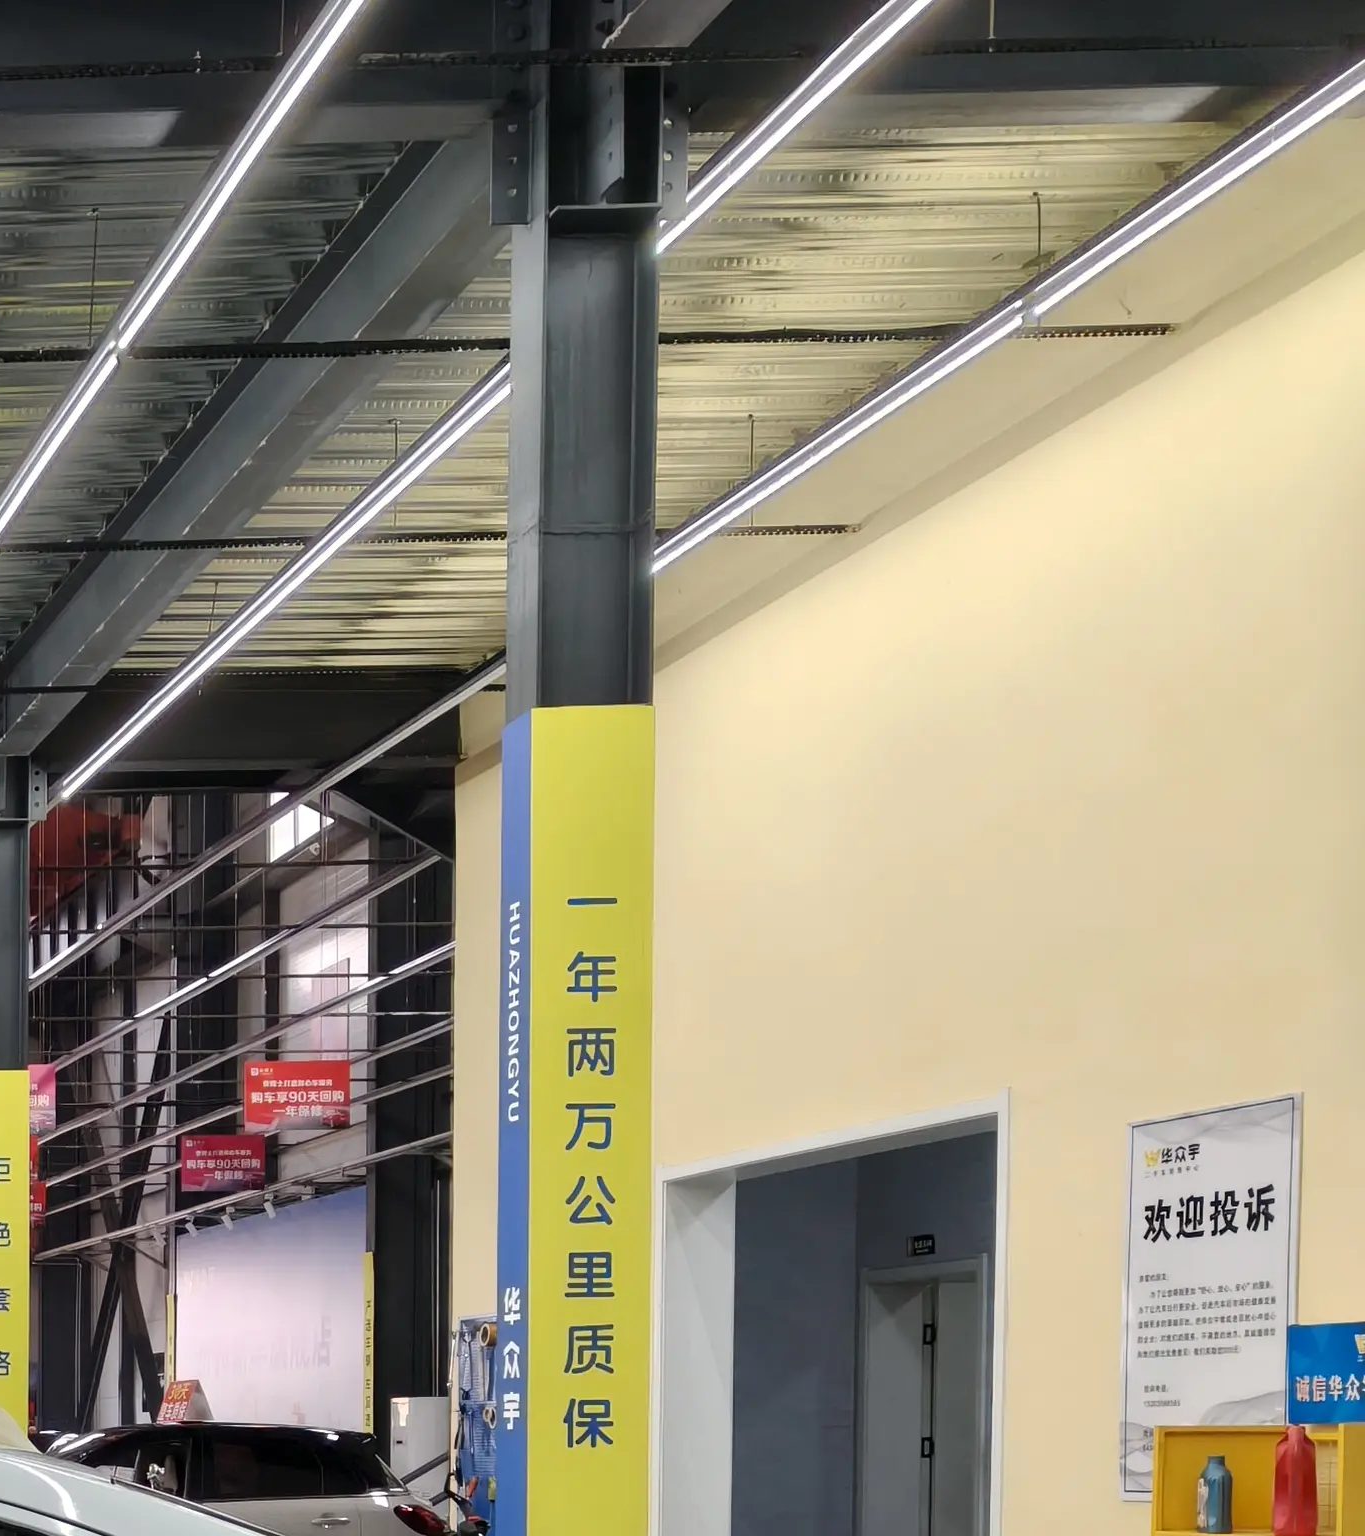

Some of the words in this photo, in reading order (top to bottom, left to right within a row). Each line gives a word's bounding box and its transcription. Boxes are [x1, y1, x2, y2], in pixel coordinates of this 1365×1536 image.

[508, 901, 521, 1122] HUAZHONGYU
[251, 1090, 344, 1104] 购车享90天回购
[273, 1105, 322, 1117] 一年保修
[186, 1159, 260, 1169] 购车享90天回购
[1161, 1143, 1201, 1164] 华众宇
[563, 897, 618, 1448] 一年两万公里质保
[1143, 1184, 1276, 1243] 欢迎投诉
[503, 1287, 521, 1430] 华众宇
[1295, 1373, 1365, 1402] 诚信华众
